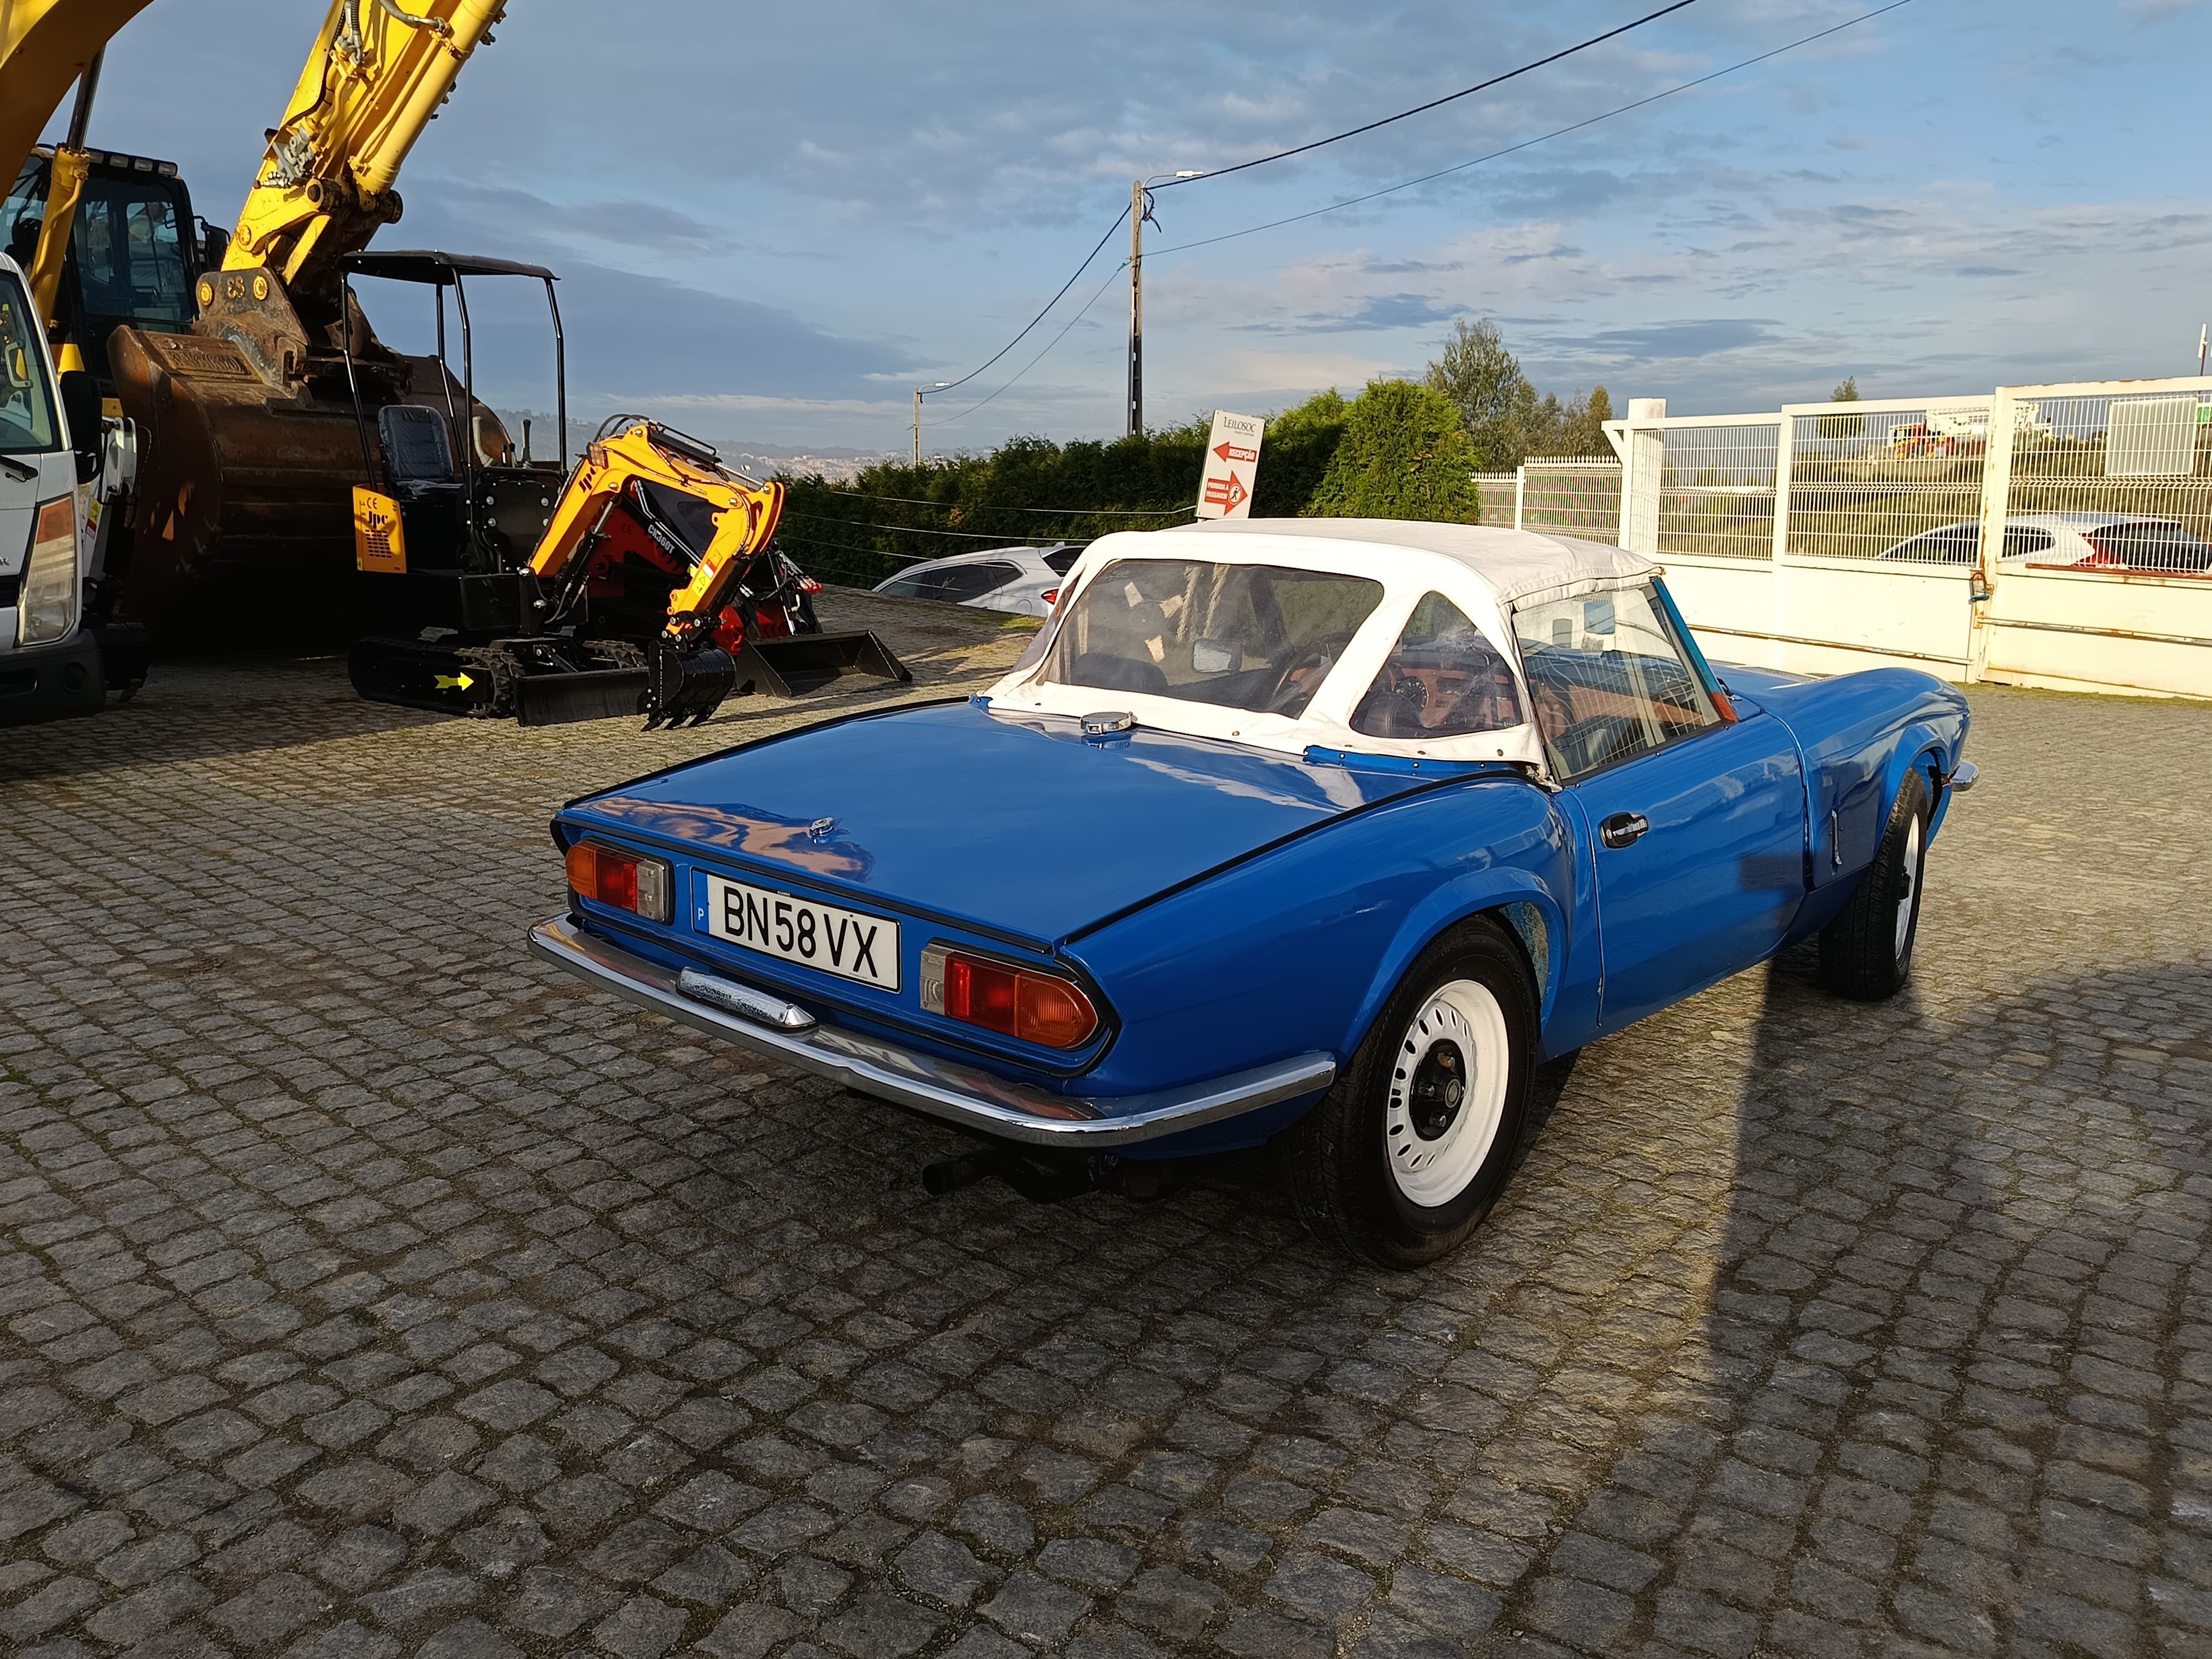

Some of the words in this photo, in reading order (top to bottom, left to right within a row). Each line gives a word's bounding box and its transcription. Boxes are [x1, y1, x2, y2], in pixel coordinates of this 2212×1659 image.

[1224, 416, 1256, 433] LEILOSOC
[367, 497, 377, 510] CE
[648, 524, 675, 554] CK360T
[698, 907, 704, 921] P
